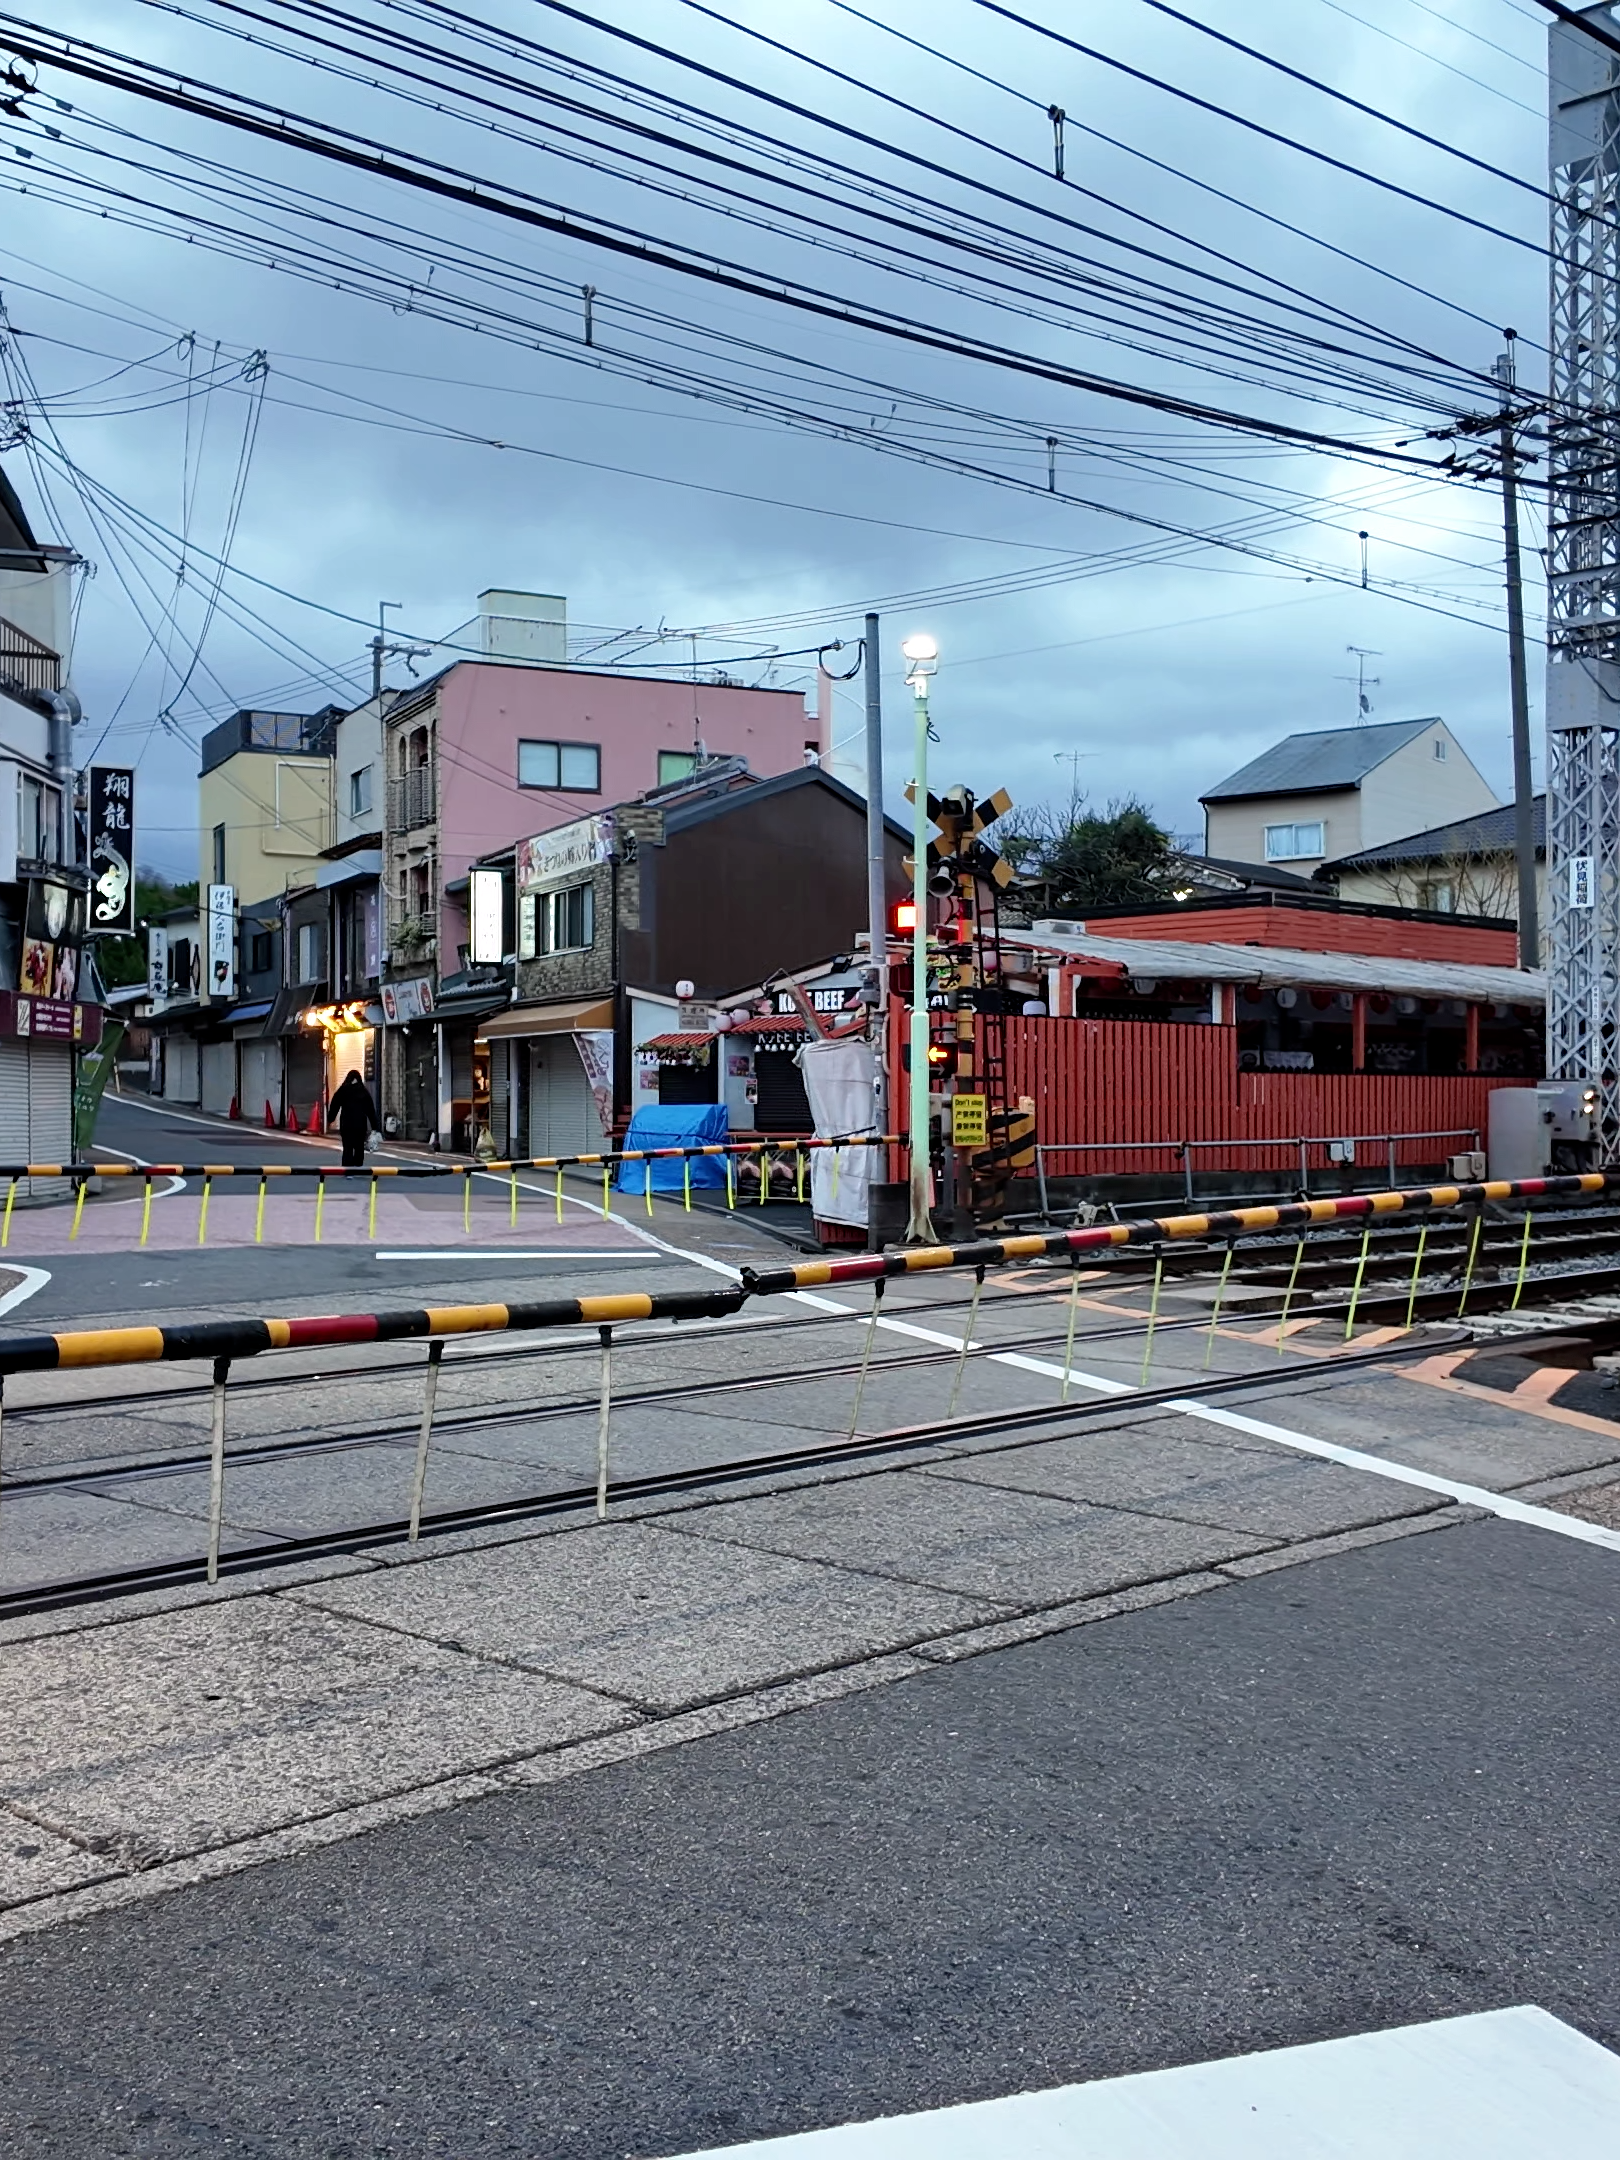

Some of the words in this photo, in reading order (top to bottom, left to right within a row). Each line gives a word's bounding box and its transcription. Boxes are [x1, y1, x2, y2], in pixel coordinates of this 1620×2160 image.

[102, 772, 131, 830] 翔龍
[1575, 859, 1588, 905] 伏見稲荷
[814, 989, 845, 1011] BEEF
